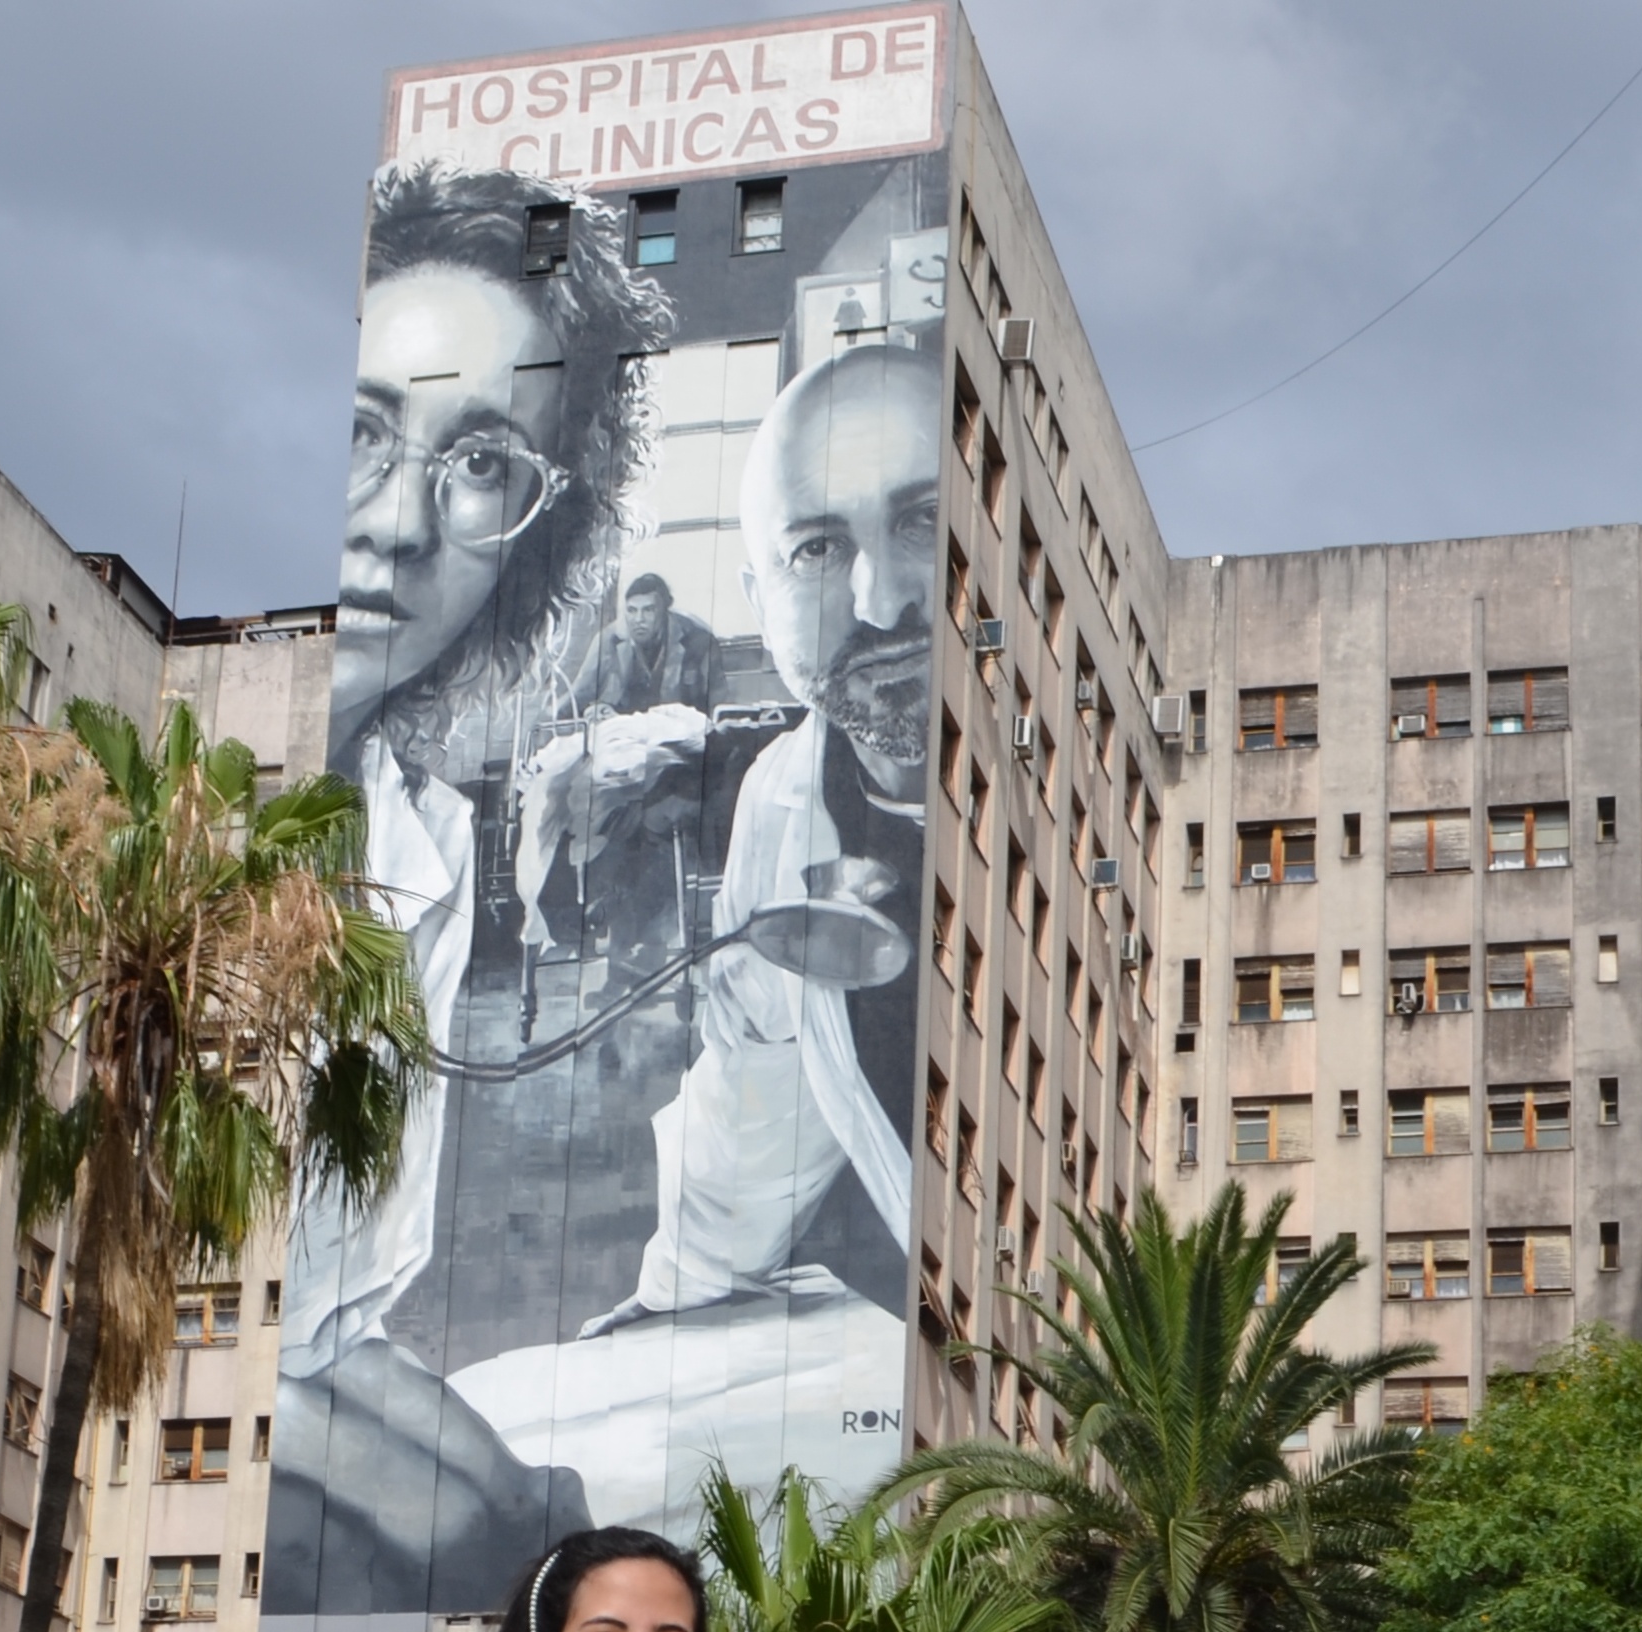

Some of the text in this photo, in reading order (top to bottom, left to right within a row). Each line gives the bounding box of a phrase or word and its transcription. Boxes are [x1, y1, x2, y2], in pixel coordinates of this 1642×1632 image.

[411, 22, 927, 134] HOSPITAL DE
[500, 97, 840, 179] CLINICAS
